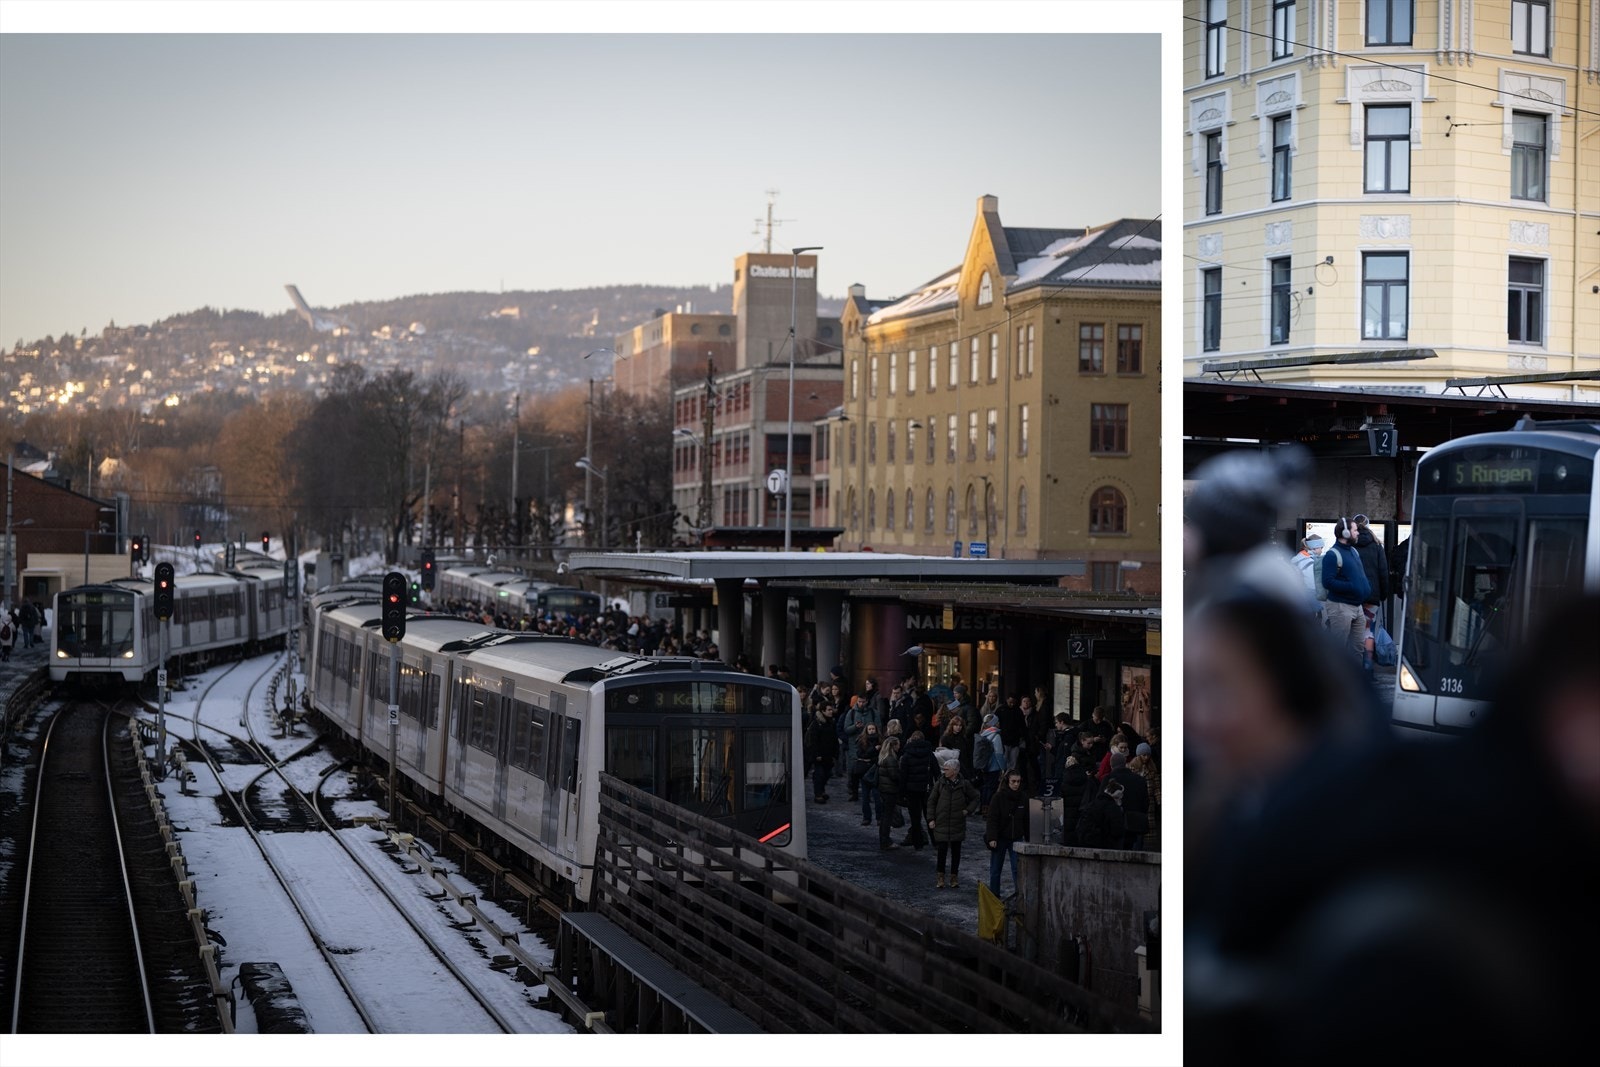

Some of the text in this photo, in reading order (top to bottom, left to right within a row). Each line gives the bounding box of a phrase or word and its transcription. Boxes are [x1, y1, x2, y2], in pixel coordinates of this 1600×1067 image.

[1381, 431, 1389, 448] 2
[1456, 463, 1533, 485] 5 Ringen
[770, 477, 779, 491] T
[1075, 640, 1085, 654] 2
[159, 673, 165, 682] S
[1440, 677, 1464, 694] 3136
[655, 692, 664, 706] 3
[390, 710, 397, 719] S
[1043, 784, 1055, 797] 3
